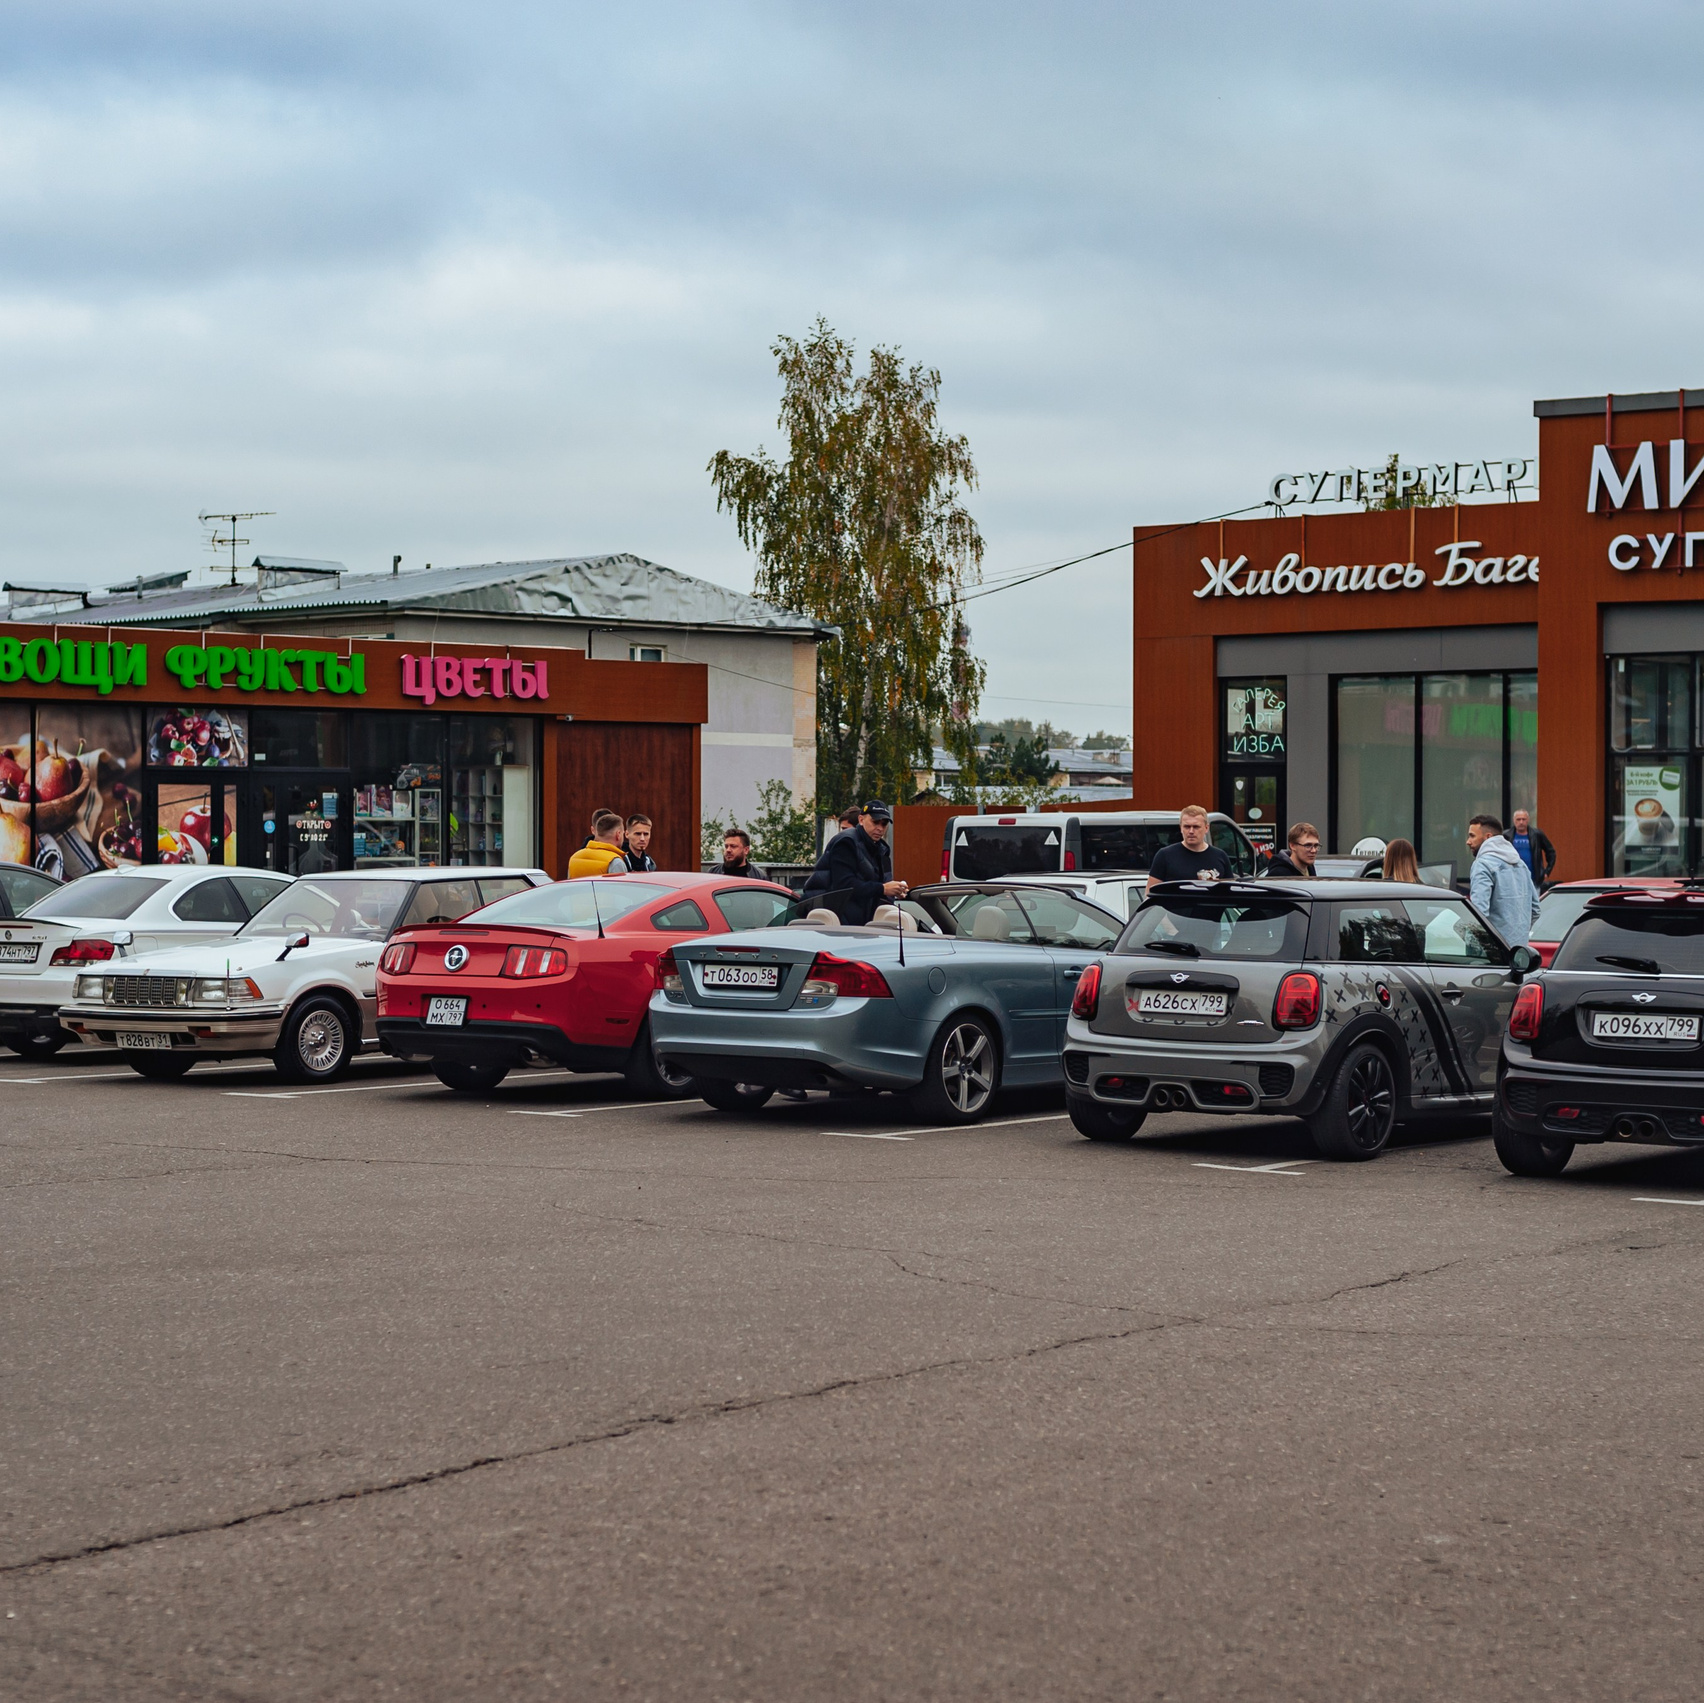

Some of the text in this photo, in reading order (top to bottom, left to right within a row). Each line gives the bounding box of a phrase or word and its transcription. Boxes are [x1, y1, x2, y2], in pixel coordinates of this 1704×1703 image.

[1269, 457, 1539, 505] СУПЕРМАР
[1193, 553, 1426, 598] Живопись
[0, 637, 367, 694] ВОЩИ ФРУКТЫ
[400, 654, 549, 705] ЦВЕТЫ
[1232, 687, 1286, 713] ГАЛЕРЕЯ
[1241, 713, 1275, 731] АРТ
[1233, 734, 1285, 753] ИЗБА
[710, 967, 773, 984] Т063ОО 58
[1143, 993, 1223, 1011] А626СХ 799
[1599, 1017, 1694, 1036] К096ХХ 799
[119, 1034, 155, 1047] Т828ВТ
